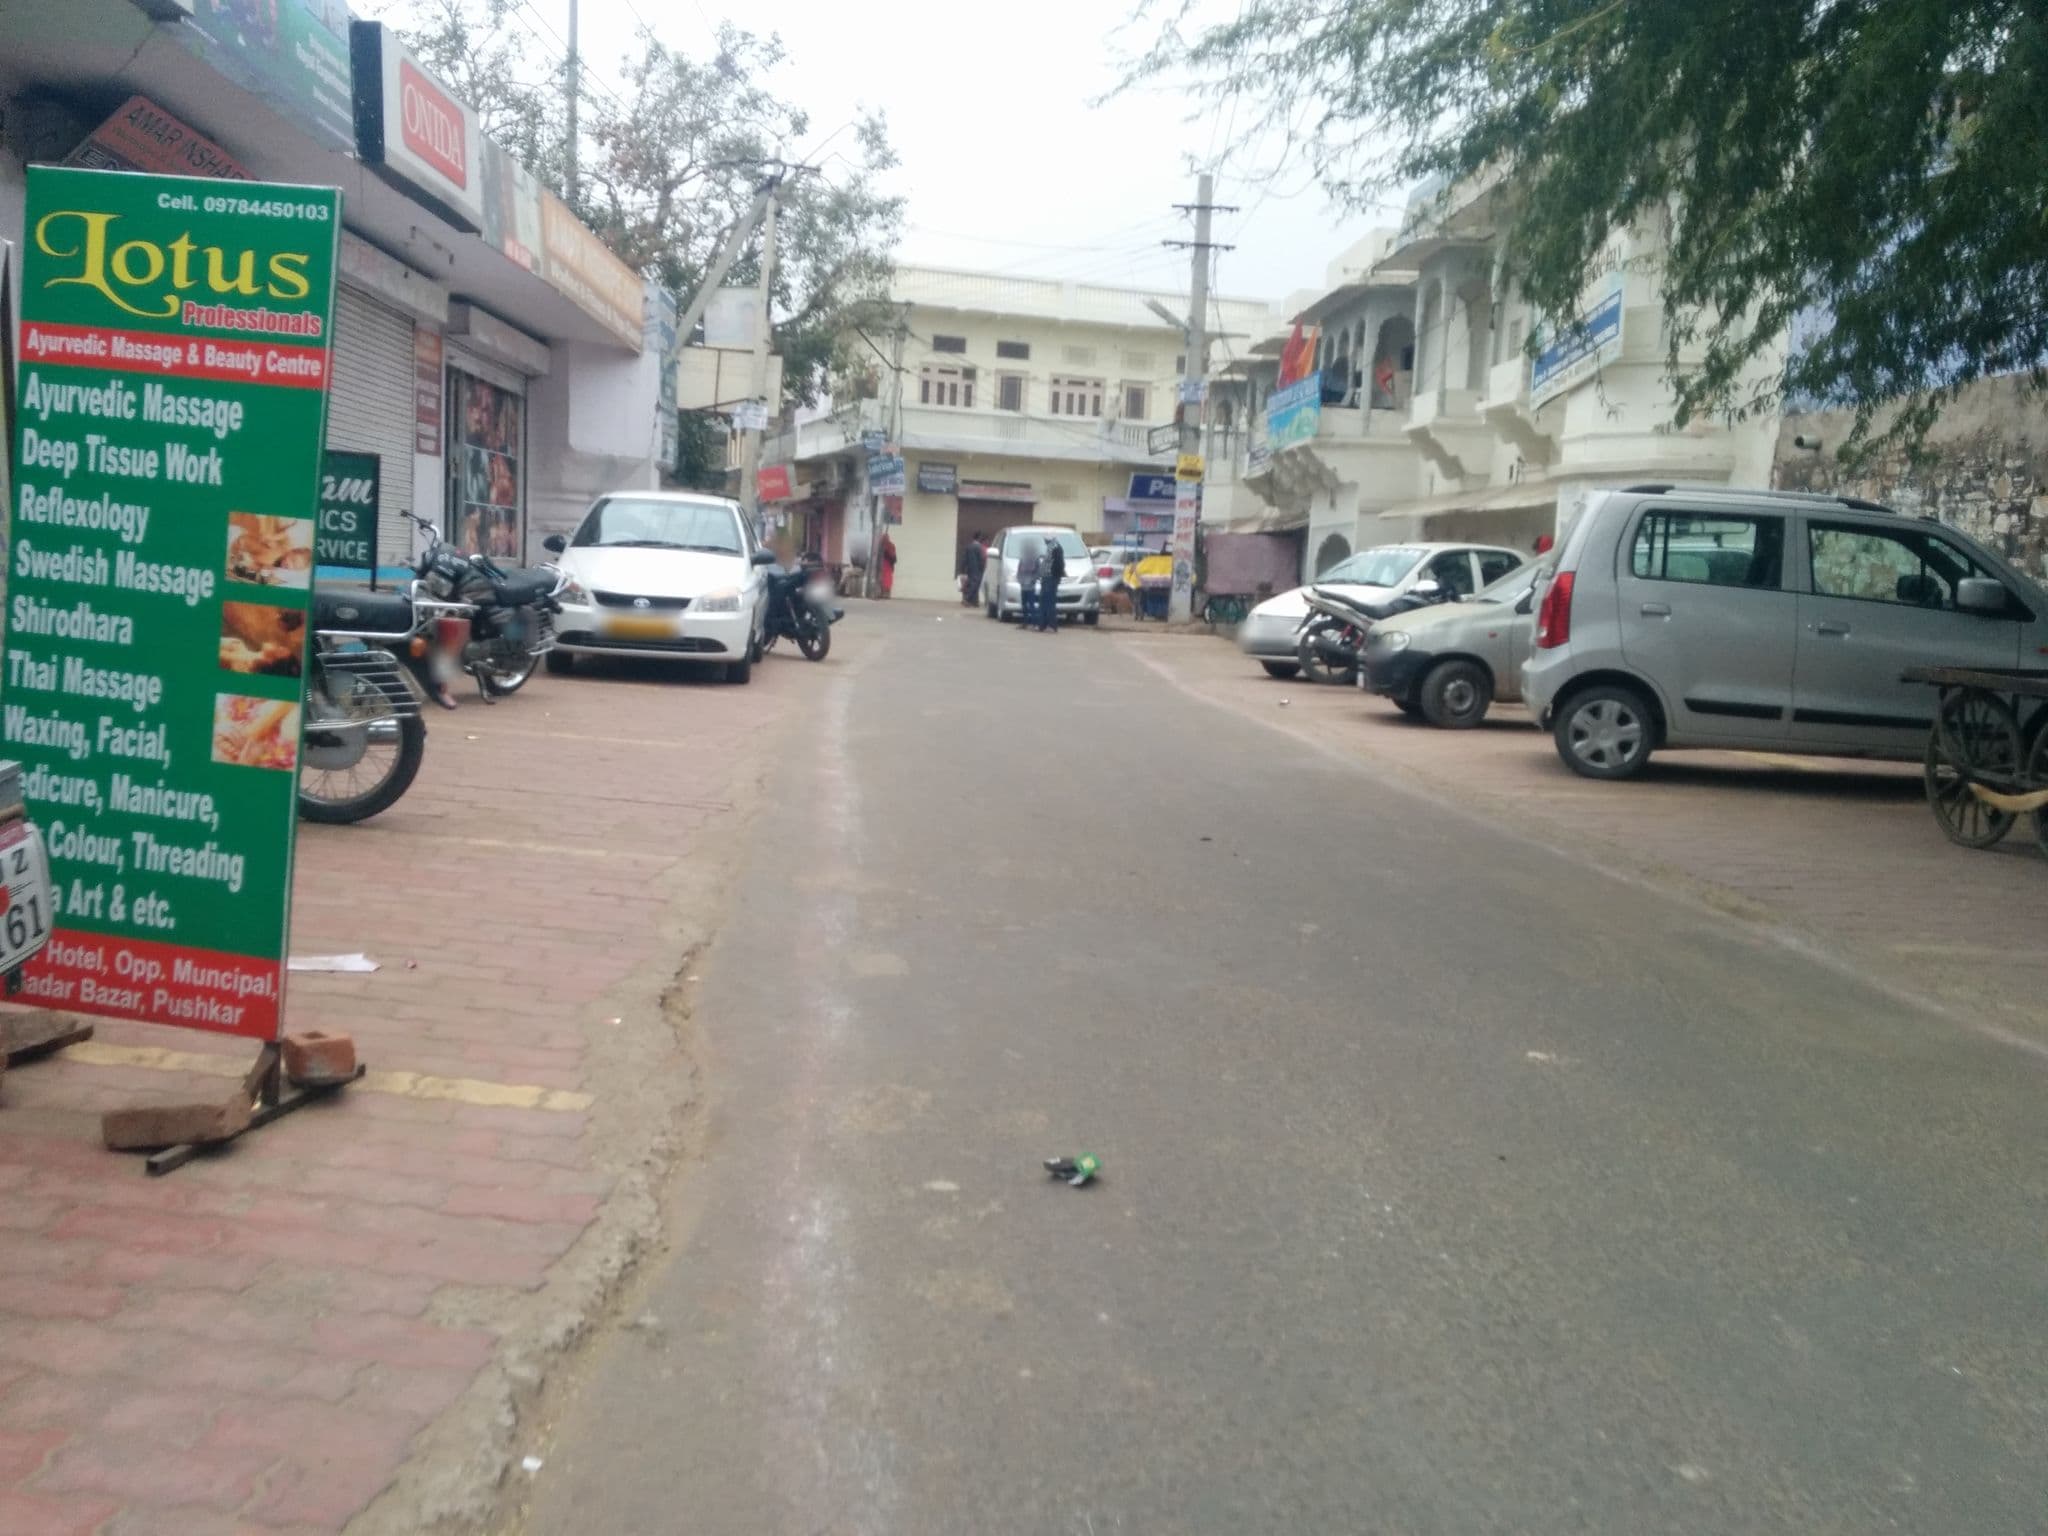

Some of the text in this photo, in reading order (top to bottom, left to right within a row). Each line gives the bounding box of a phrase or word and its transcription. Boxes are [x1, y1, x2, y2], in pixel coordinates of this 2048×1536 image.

[403, 82, 464, 172] ONIDA
[157, 193, 329, 222] Cell. 09784450103
[35, 210, 311, 318] Lotus
[181, 300, 323, 337] Professionals
[27, 328, 321, 377] Ayurvedic Massage & Beauty Centre
[23, 371, 244, 440] Ayurvedic Massage
[22, 428, 223, 486] Deep Tissue Work
[19, 483, 151, 544] Reflexology
[15, 539, 215, 607] Swedish Massage
[11, 594, 133, 645] Shirodhara
[8, 649, 163, 712] Thai Massage
[3, 703, 172, 770] Waxing, Facial,
[18, 763, 220, 832] edicure, Manicure,
[48, 820, 245, 893] Colour, Threading
[66, 878, 104, 919] Art
[109, 884, 127, 923] &
[132, 890, 176, 929] etc.
[21, 970, 246, 1027] adar Bazar, Pushkar
[46, 939, 279, 1001] Hotel, Opp. Muncipal,
